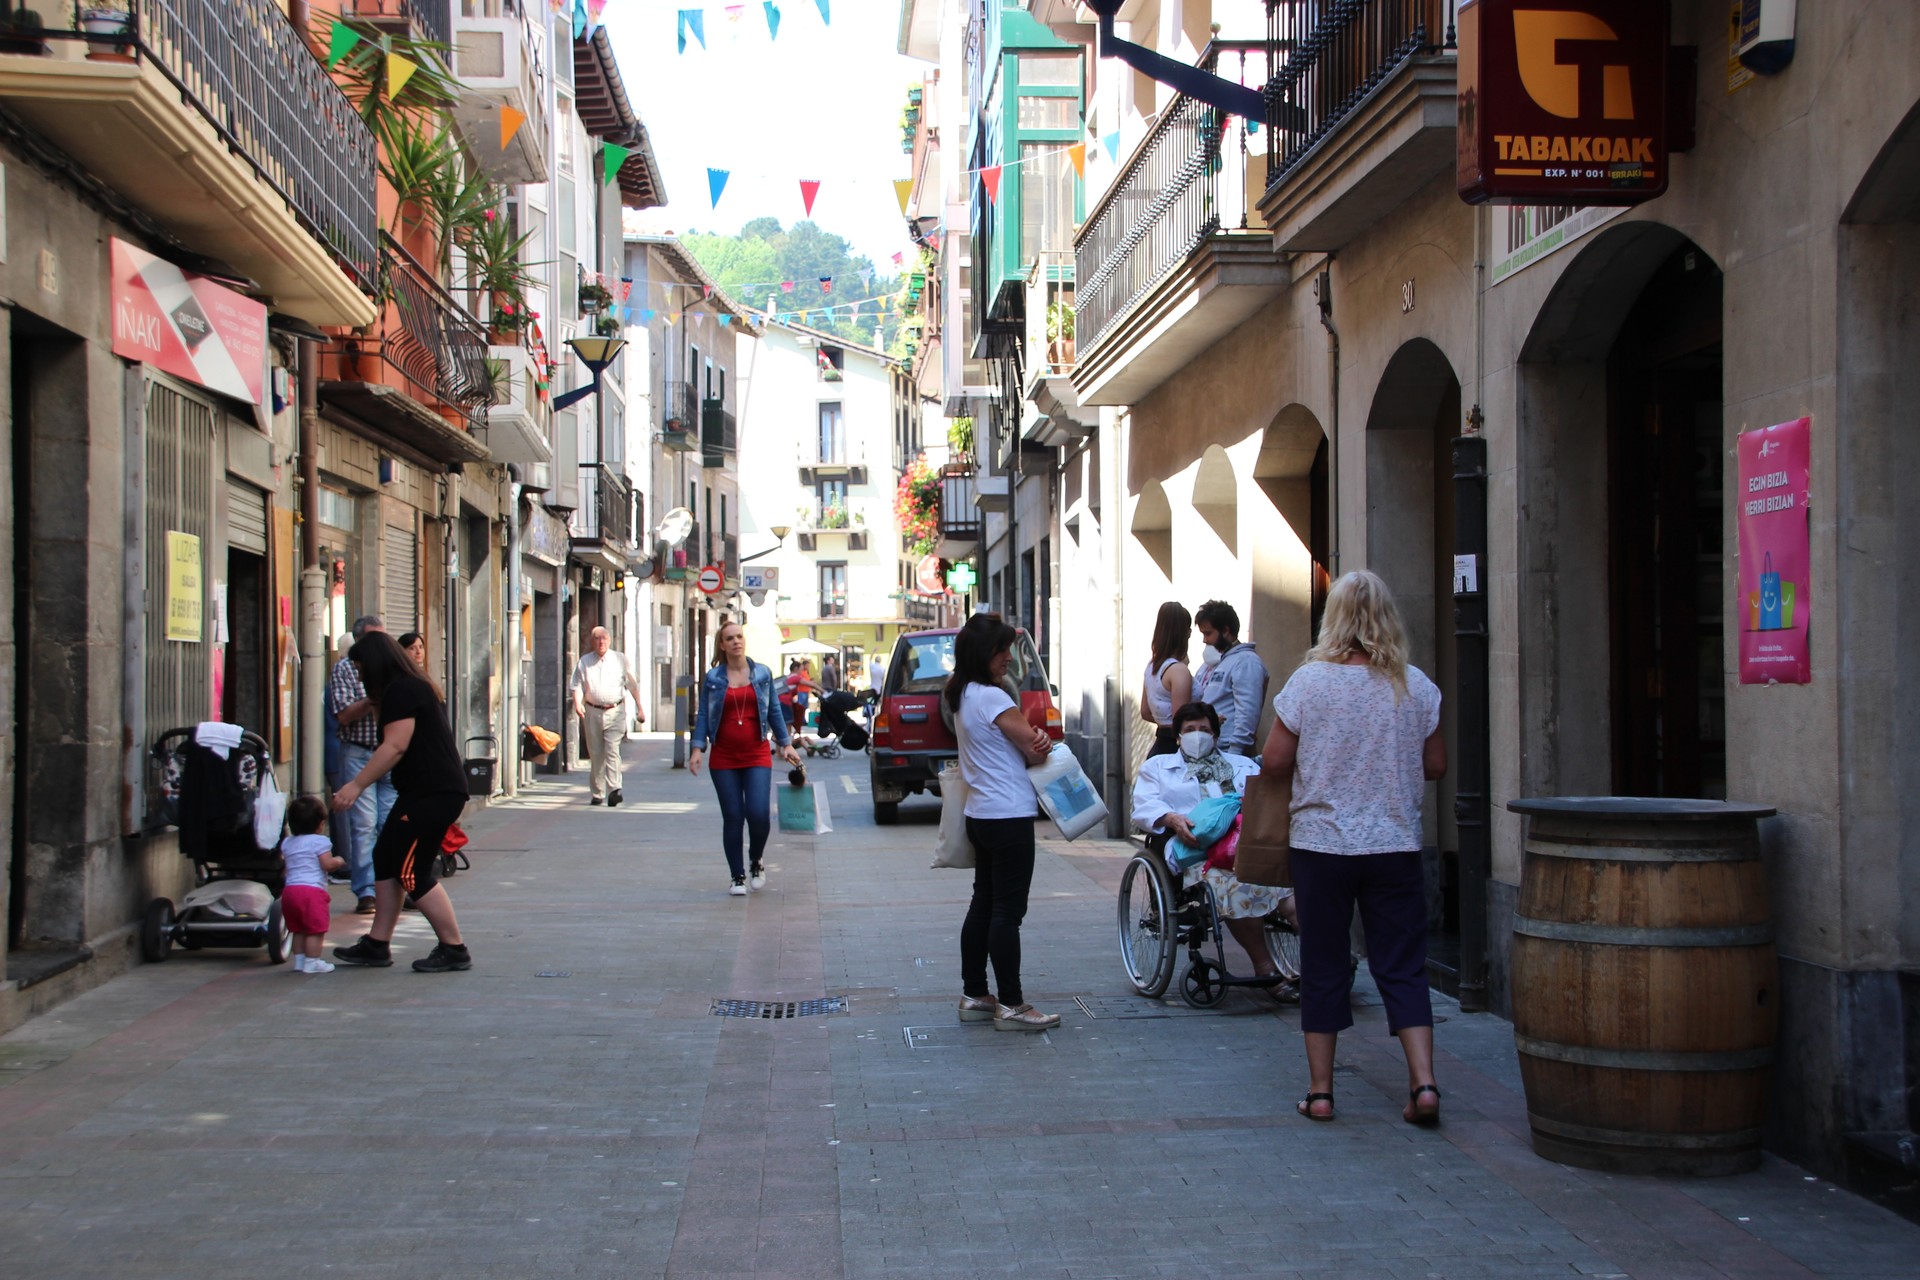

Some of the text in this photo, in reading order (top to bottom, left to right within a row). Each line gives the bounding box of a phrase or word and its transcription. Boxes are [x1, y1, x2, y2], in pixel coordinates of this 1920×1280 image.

[1494, 135, 1654, 162] TABAKOAK
[1545, 168, 1567, 178] EXP.
[1586, 169, 1604, 178] 001
[116, 296, 161, 353] IÑAKI
[1767, 470, 1788, 489] BIZIA
[1767, 493, 1794, 512] BIZIAN
